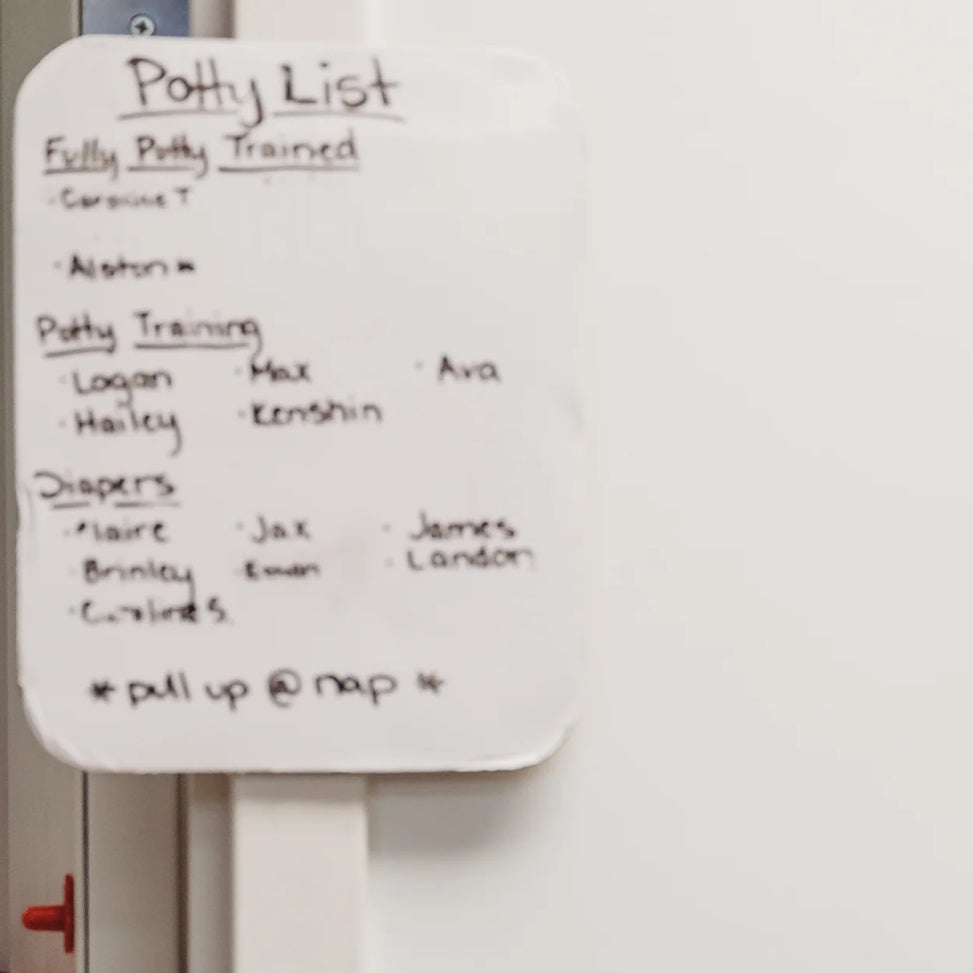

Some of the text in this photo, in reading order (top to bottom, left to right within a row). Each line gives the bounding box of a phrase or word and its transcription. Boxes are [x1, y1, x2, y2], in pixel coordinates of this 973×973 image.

[126, 57, 401, 127] Potty List
[45, 128, 359, 180] Fully Potty Trained
[37, 311, 263, 362] Potty Training
[250, 359, 311, 383] Max
[438, 354, 502, 383] Ava
[73, 371, 172, 408] Logan
[74, 405, 182, 457] Hailey
[34, 471, 175, 502] Diapers
[252, 513, 311, 545] Jax
[409, 509, 517, 541] James
[406, 545, 533, 572] Landon
[128, 668, 398, 712] pull up @ nap
